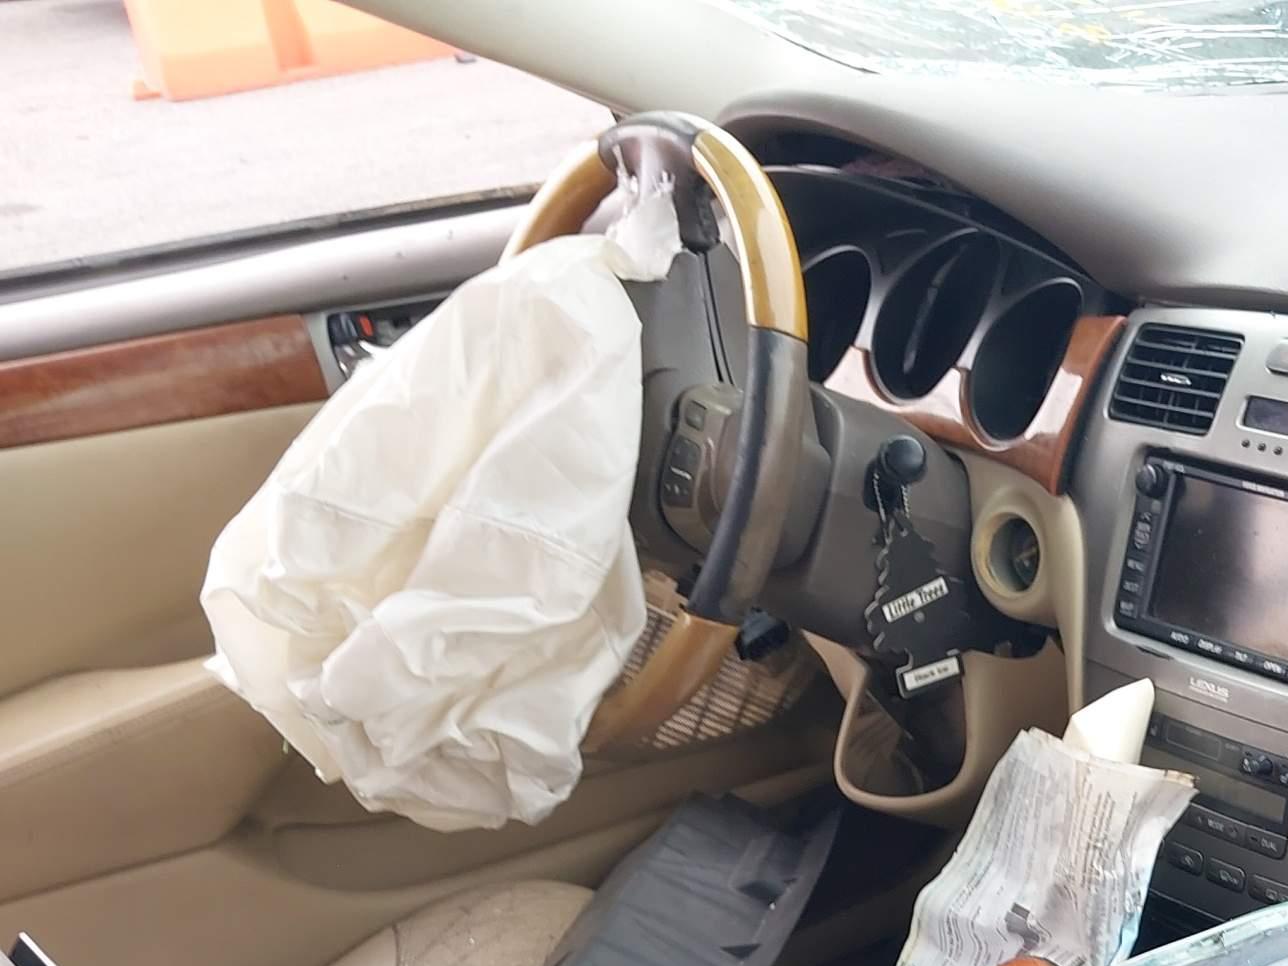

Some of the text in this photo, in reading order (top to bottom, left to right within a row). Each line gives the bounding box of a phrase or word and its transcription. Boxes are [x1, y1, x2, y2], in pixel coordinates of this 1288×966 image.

[887, 584, 946, 619] Little Trees
[1188, 676, 1230, 698] LEXUS
